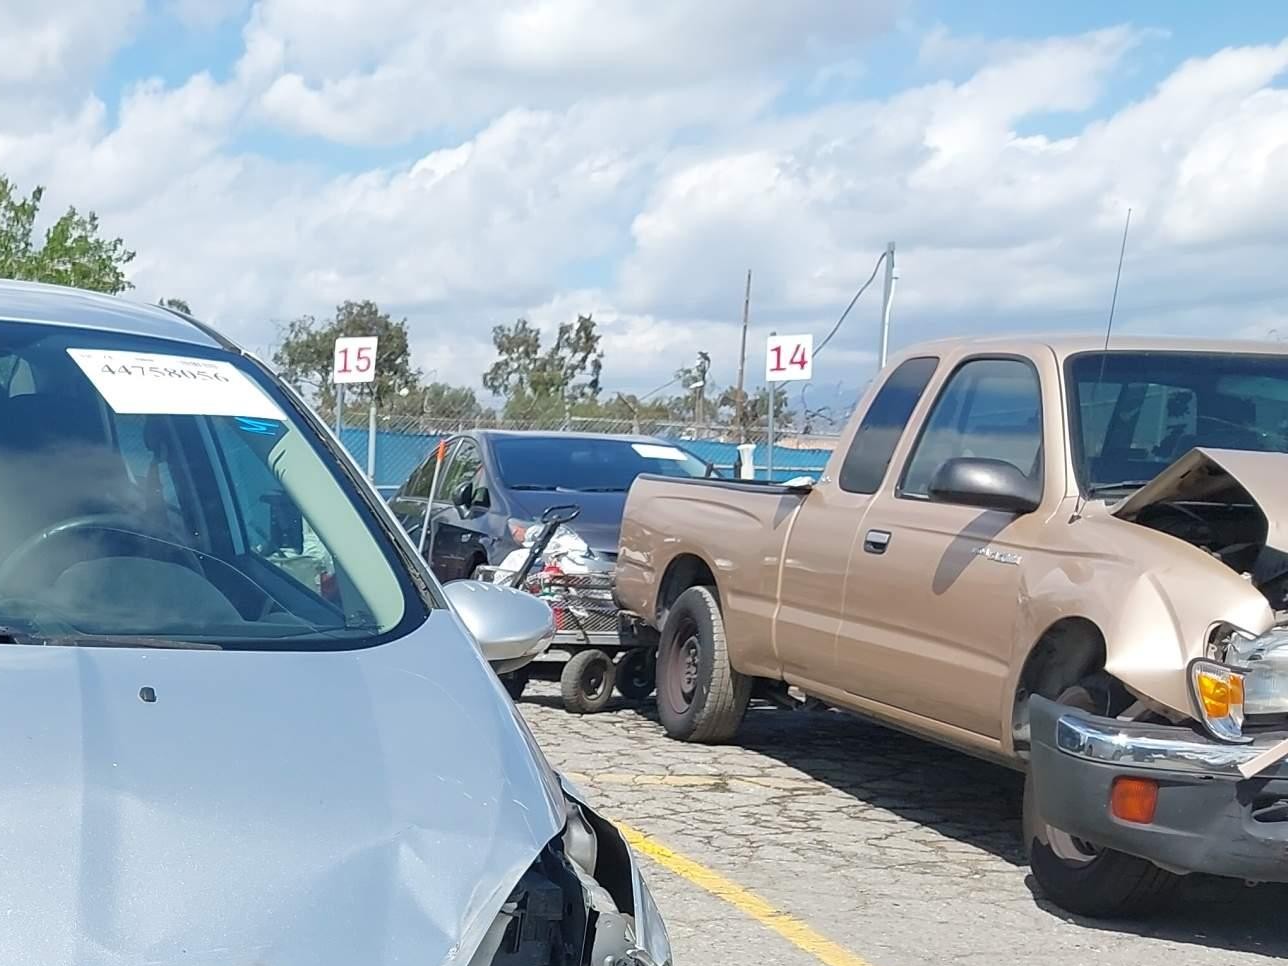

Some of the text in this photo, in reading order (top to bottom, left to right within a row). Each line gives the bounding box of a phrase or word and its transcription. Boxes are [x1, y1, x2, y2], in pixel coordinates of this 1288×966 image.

[337, 347, 372, 373] 15
[769, 344, 808, 371] 14
[101, 364, 230, 382] 44758056
